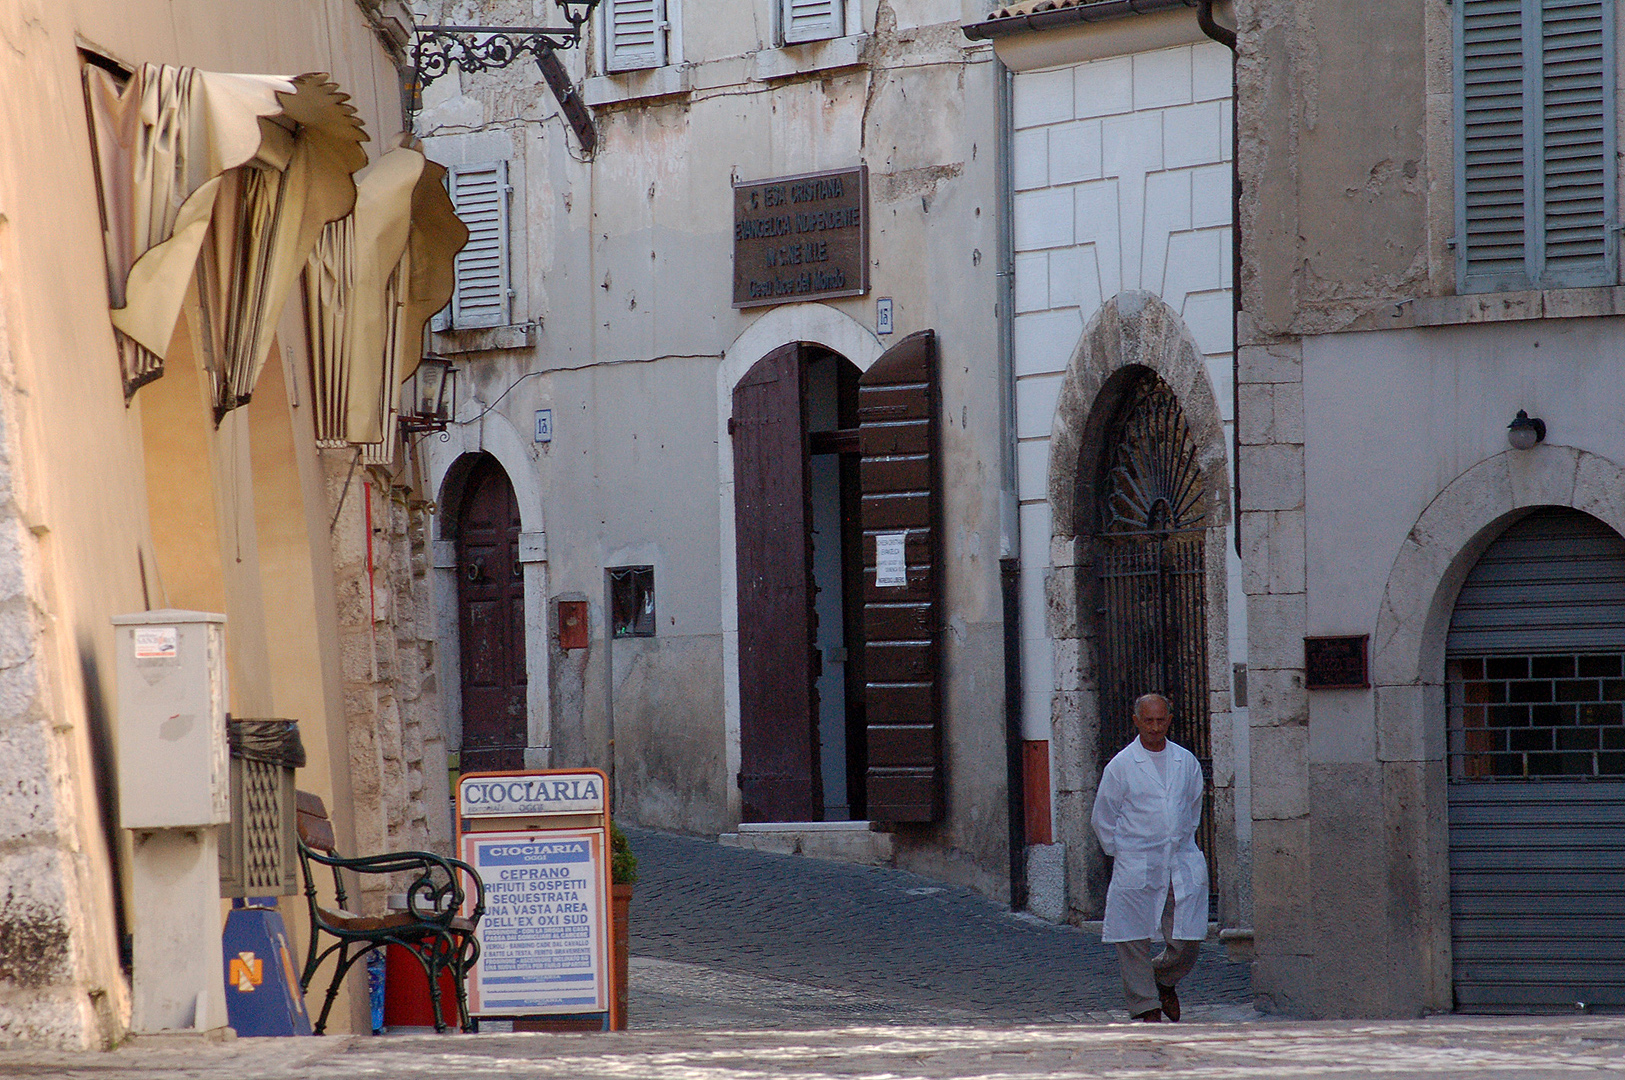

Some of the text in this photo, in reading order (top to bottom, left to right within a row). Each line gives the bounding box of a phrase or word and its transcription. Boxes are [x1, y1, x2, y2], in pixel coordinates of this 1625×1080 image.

[791, 178, 845, 204] CRISTIANA
[735, 208, 860, 241] EVANGELICA INDIPENDENTE
[797, 272, 811, 293] del
[815, 267, 846, 291] Mondo
[465, 781, 599, 804] CIOCIARIA
[489, 844, 584, 857] CIOCIARIA
[500, 867, 570, 880] CEPRANO
[484, 879, 586, 893] RIFIUTI SOSPETTI
[493, 891, 578, 905] SEQUESTRATA
[484, 902, 588, 916] UNA VASTA AREA
[485, 914, 588, 928] DELL'EX OXI SUD
